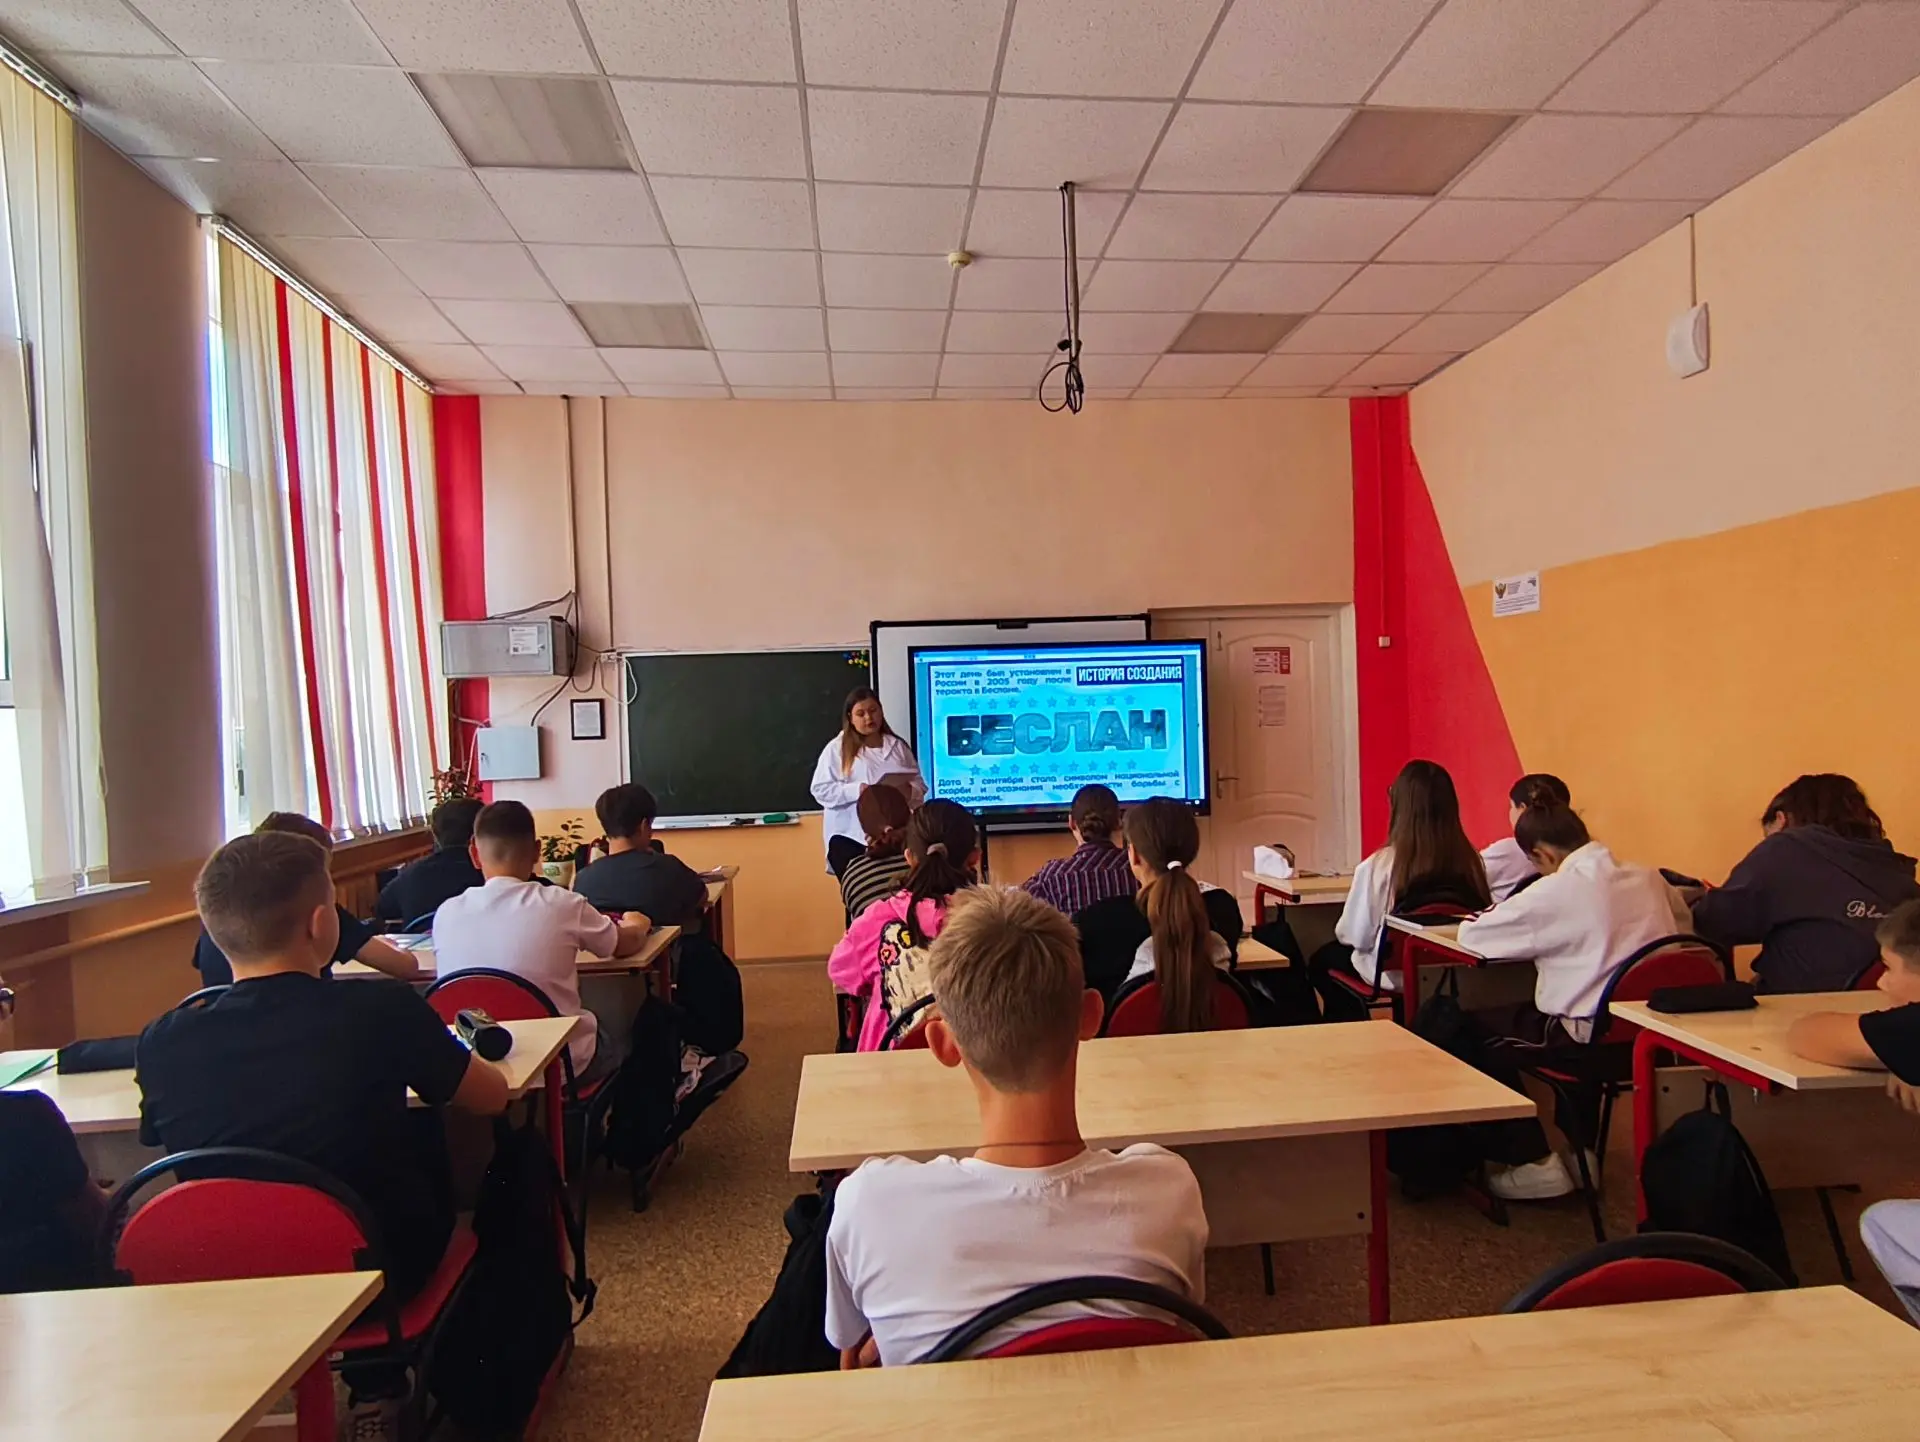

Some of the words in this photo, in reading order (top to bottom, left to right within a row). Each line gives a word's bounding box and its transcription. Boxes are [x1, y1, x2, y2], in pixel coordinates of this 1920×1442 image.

[934, 671, 955, 679] Этот
[960, 671, 982, 679] день
[986, 669, 1005, 677] был
[1009, 668, 1061, 678] установлен
[987, 678, 1010, 686] 2005
[1017, 678, 1038, 686] году
[1045, 676, 1071, 684] после
[1078, 667, 1125, 682] ИСТОРИЯ
[1126, 665, 1182, 681] СОЗДАНИЯ
[936, 688, 972, 697] теракта
[981, 685, 1022, 694] Беслане.
[946, 708, 1167, 757] БЕСЛАН
[938, 779, 961, 787] Дата
[981, 776, 1023, 785] сентября
[1030, 775, 1057, 783] стала
[1115, 769, 1180, 780] национальной
[938, 787, 971, 795] скорби
[995, 784, 1043, 793] осознания
[1131, 780, 1166, 788] борьбы
